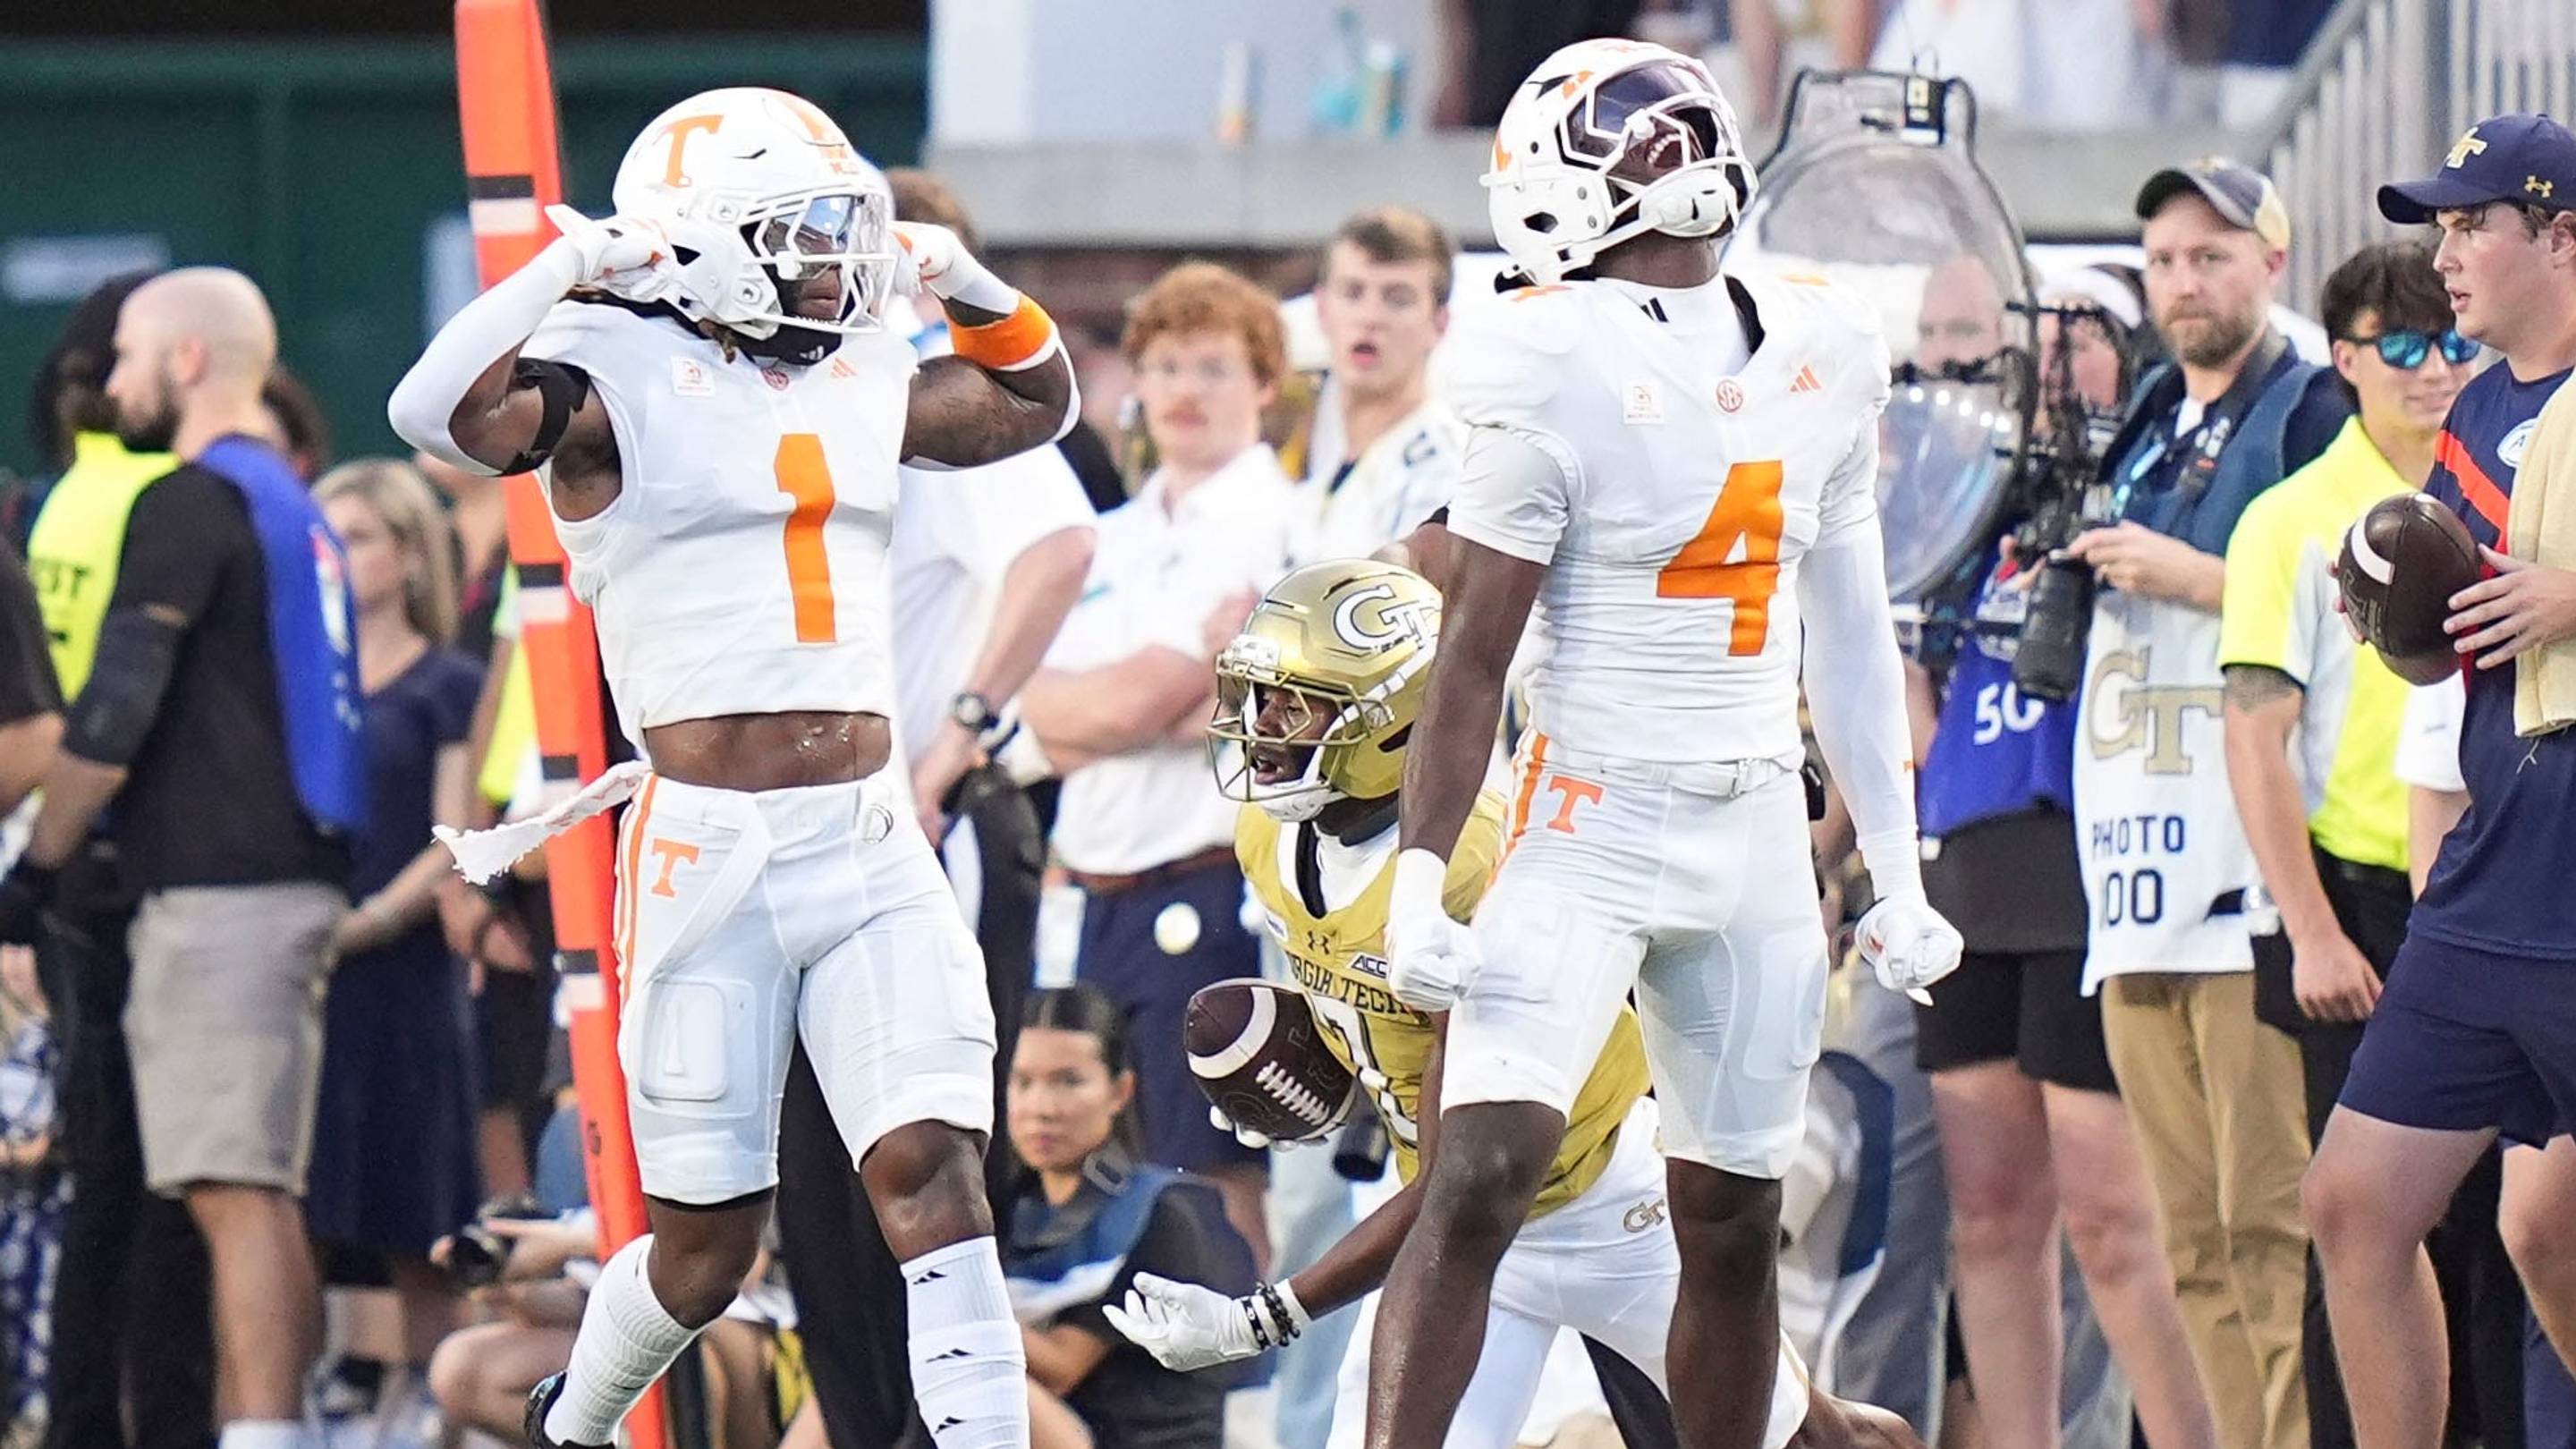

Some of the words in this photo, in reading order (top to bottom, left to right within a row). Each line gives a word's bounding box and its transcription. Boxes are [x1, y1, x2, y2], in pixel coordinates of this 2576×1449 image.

[653, 114, 724, 188] T
[773, 433, 836, 643] 1
[1657, 460, 1784, 657] 4
[1334, 584, 1443, 649] GT
[2087, 644, 2226, 775] GT
[1546, 775, 1604, 835] T
[649, 837, 700, 898] T
[2092, 815, 2185, 860] PHOTO
[1351, 954, 1387, 979] ACC
[1623, 1199, 1665, 1233] GT
